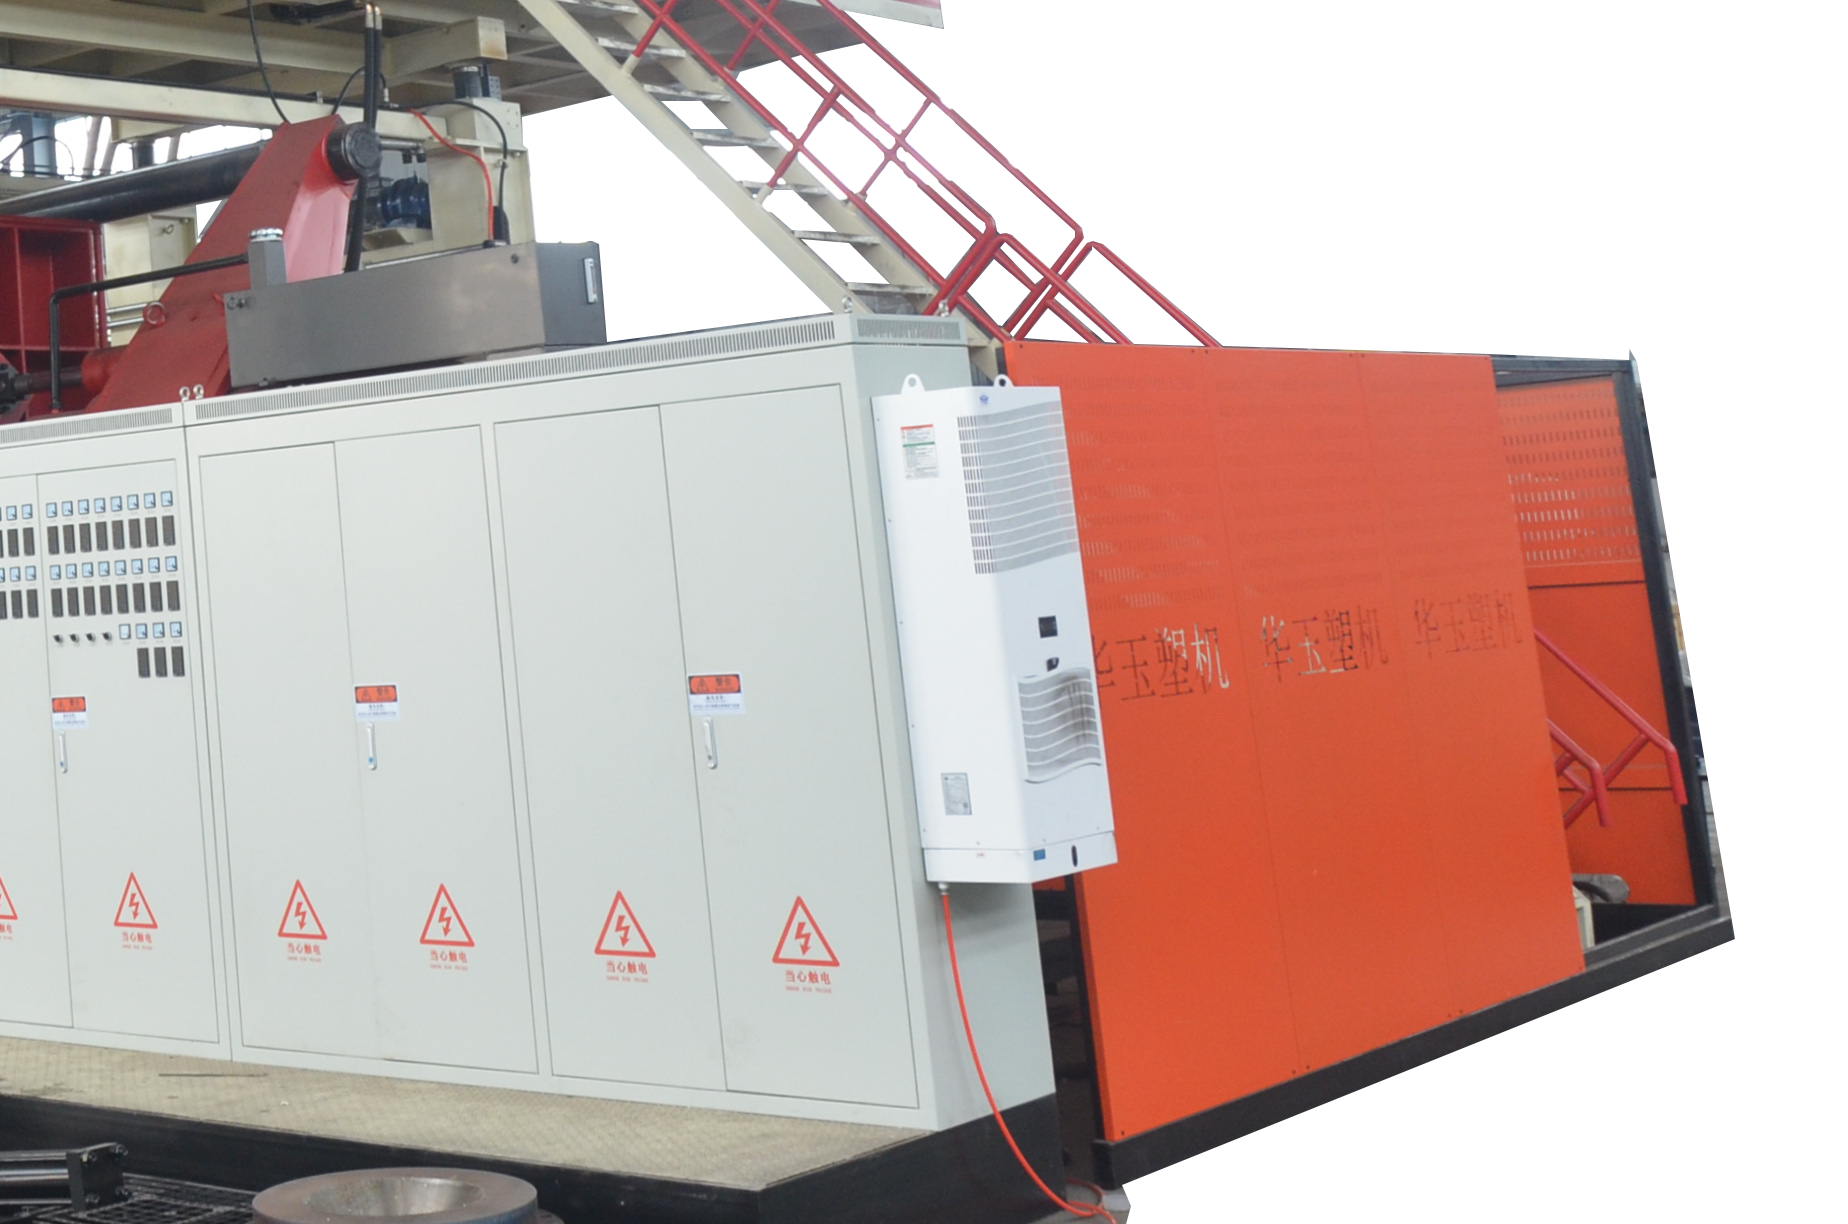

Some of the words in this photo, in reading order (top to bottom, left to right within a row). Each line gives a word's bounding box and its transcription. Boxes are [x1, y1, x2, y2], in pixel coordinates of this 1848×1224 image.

[1262, 604, 1389, 683] 华玉塑机
[1414, 588, 1524, 662] 华玉塑机
[606, 959, 649, 976] 当心触电
[785, 968, 832, 986] 当心触电
